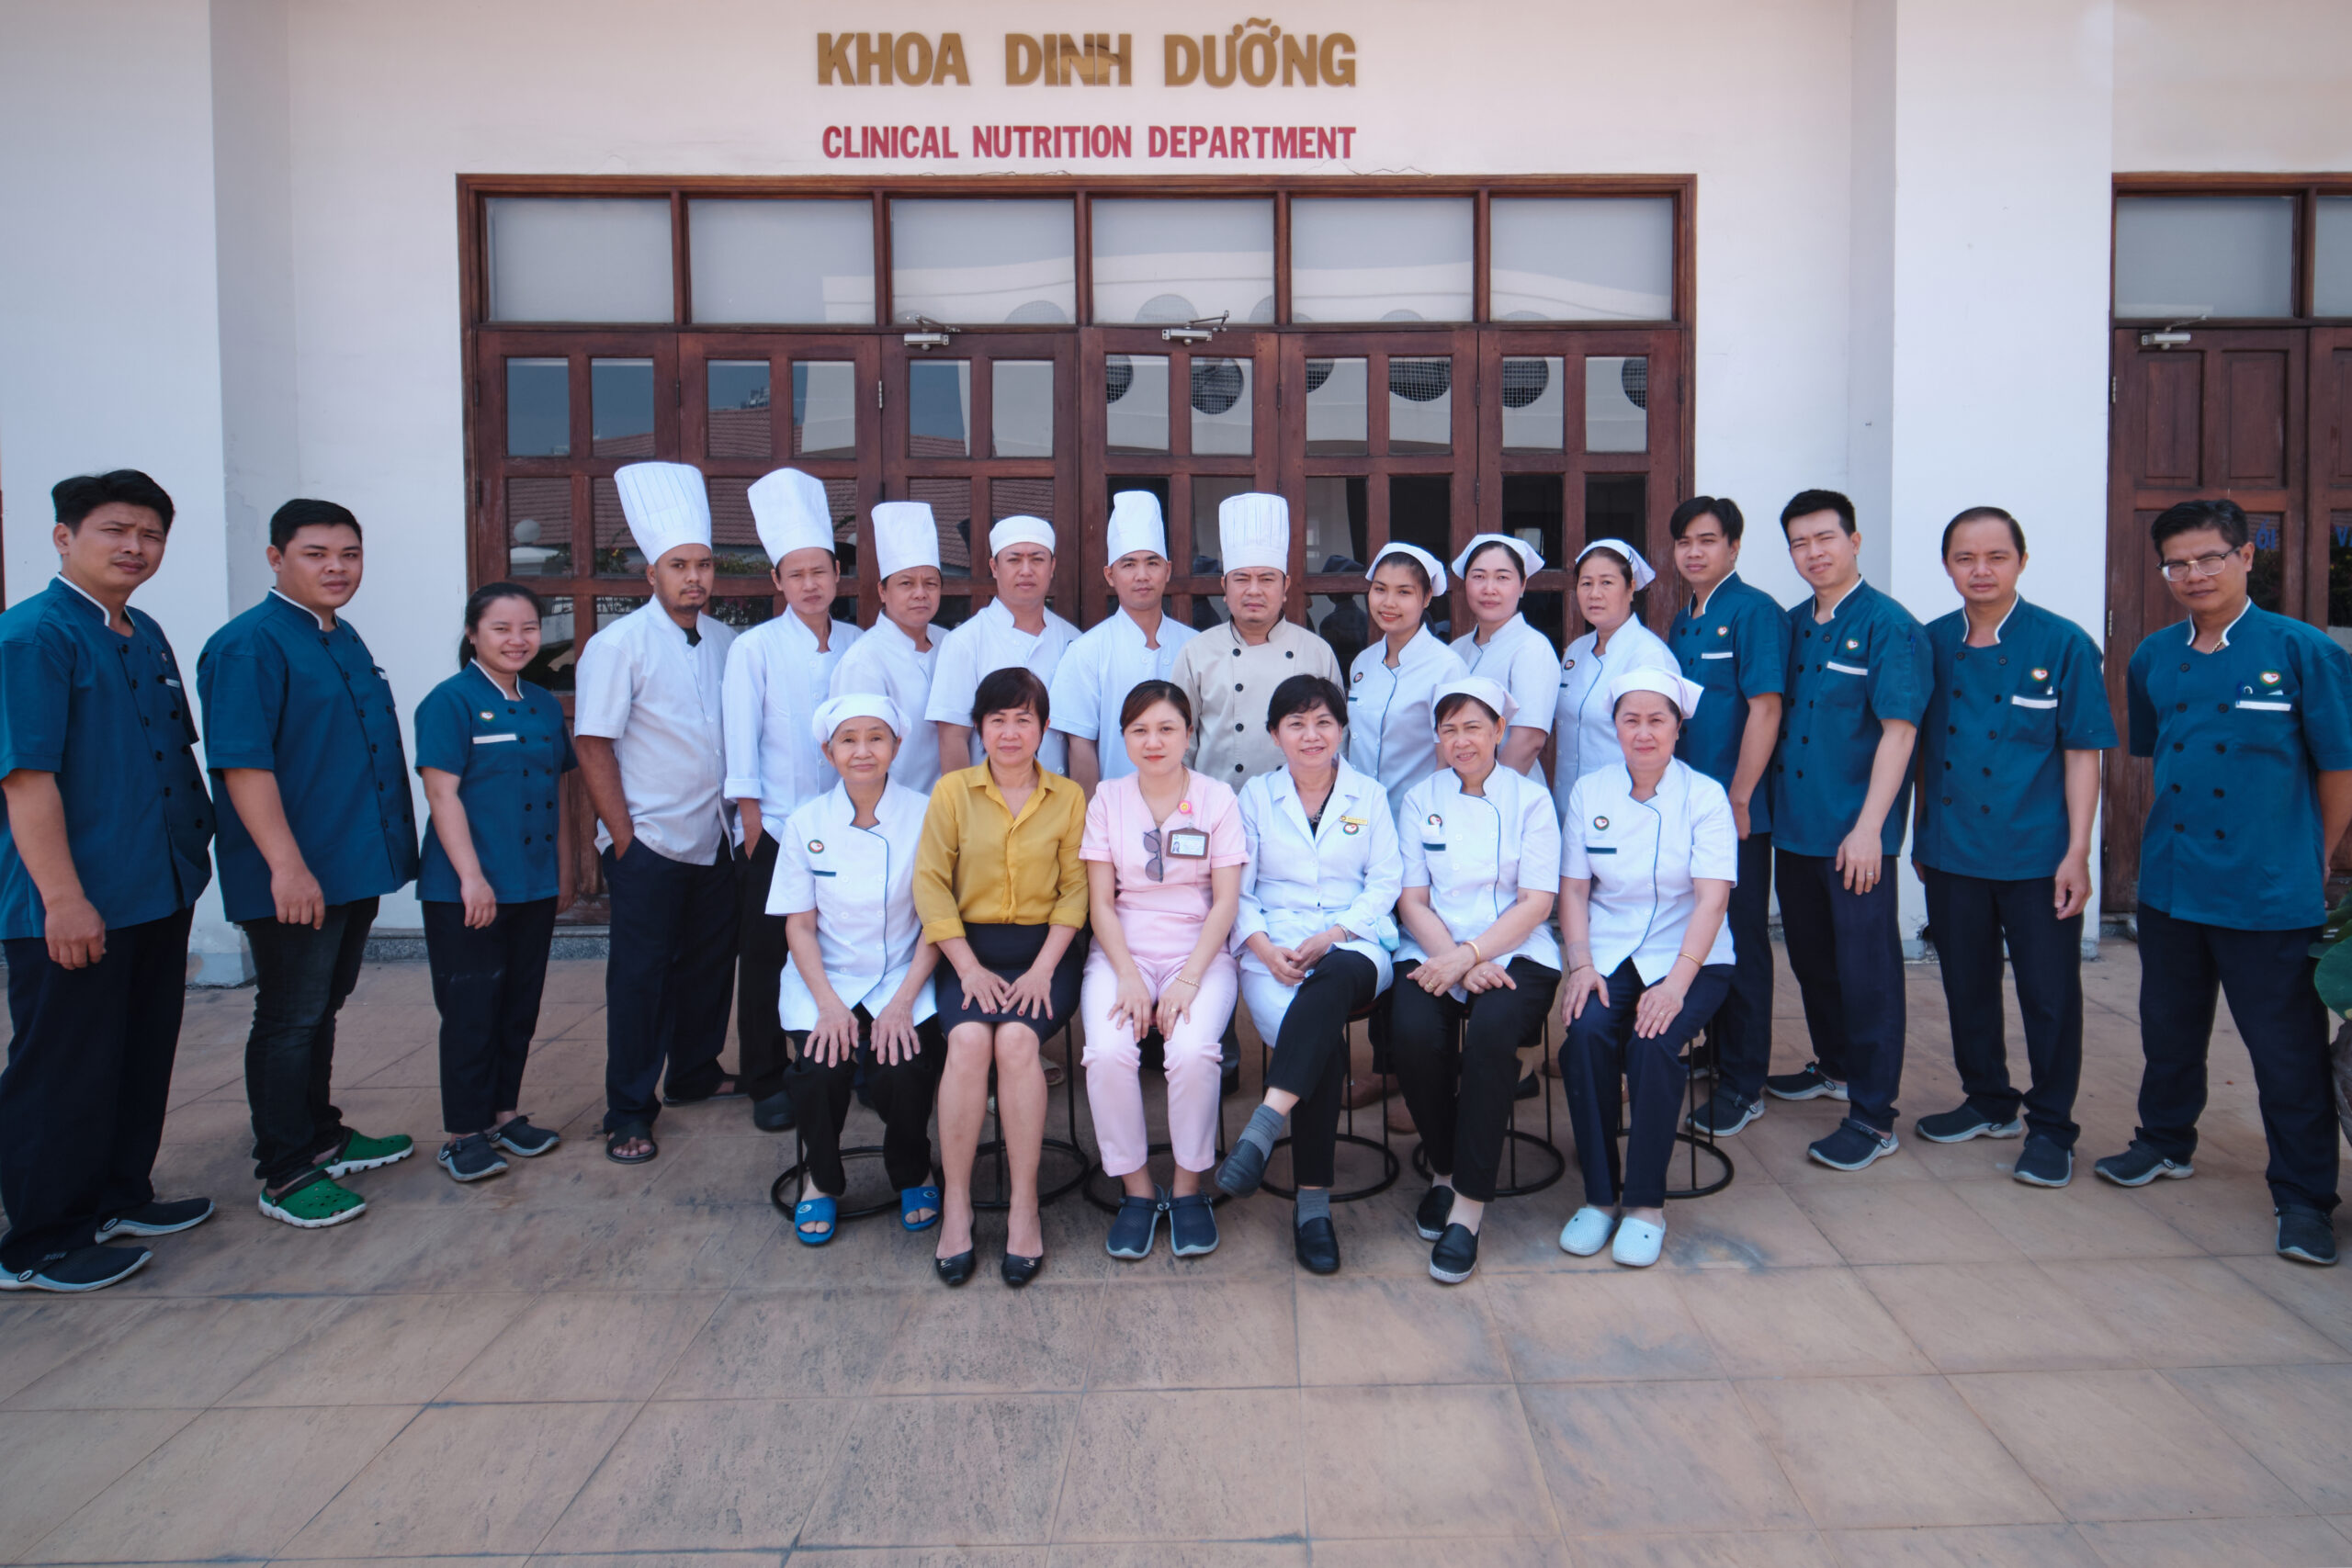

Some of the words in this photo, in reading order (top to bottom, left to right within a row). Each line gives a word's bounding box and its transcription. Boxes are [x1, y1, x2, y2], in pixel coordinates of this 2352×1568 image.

[818, 32, 969, 85] KHOA
[1005, 33, 1132, 85] DINH
[1165, 17, 1356, 87] DƯỠNG
[823, 126, 958, 158] CLINICAL
[973, 125, 1131, 158] NUTRITION
[1149, 126, 1356, 158] DEPARTMENT
[2335, 525, 2352, 547] V
